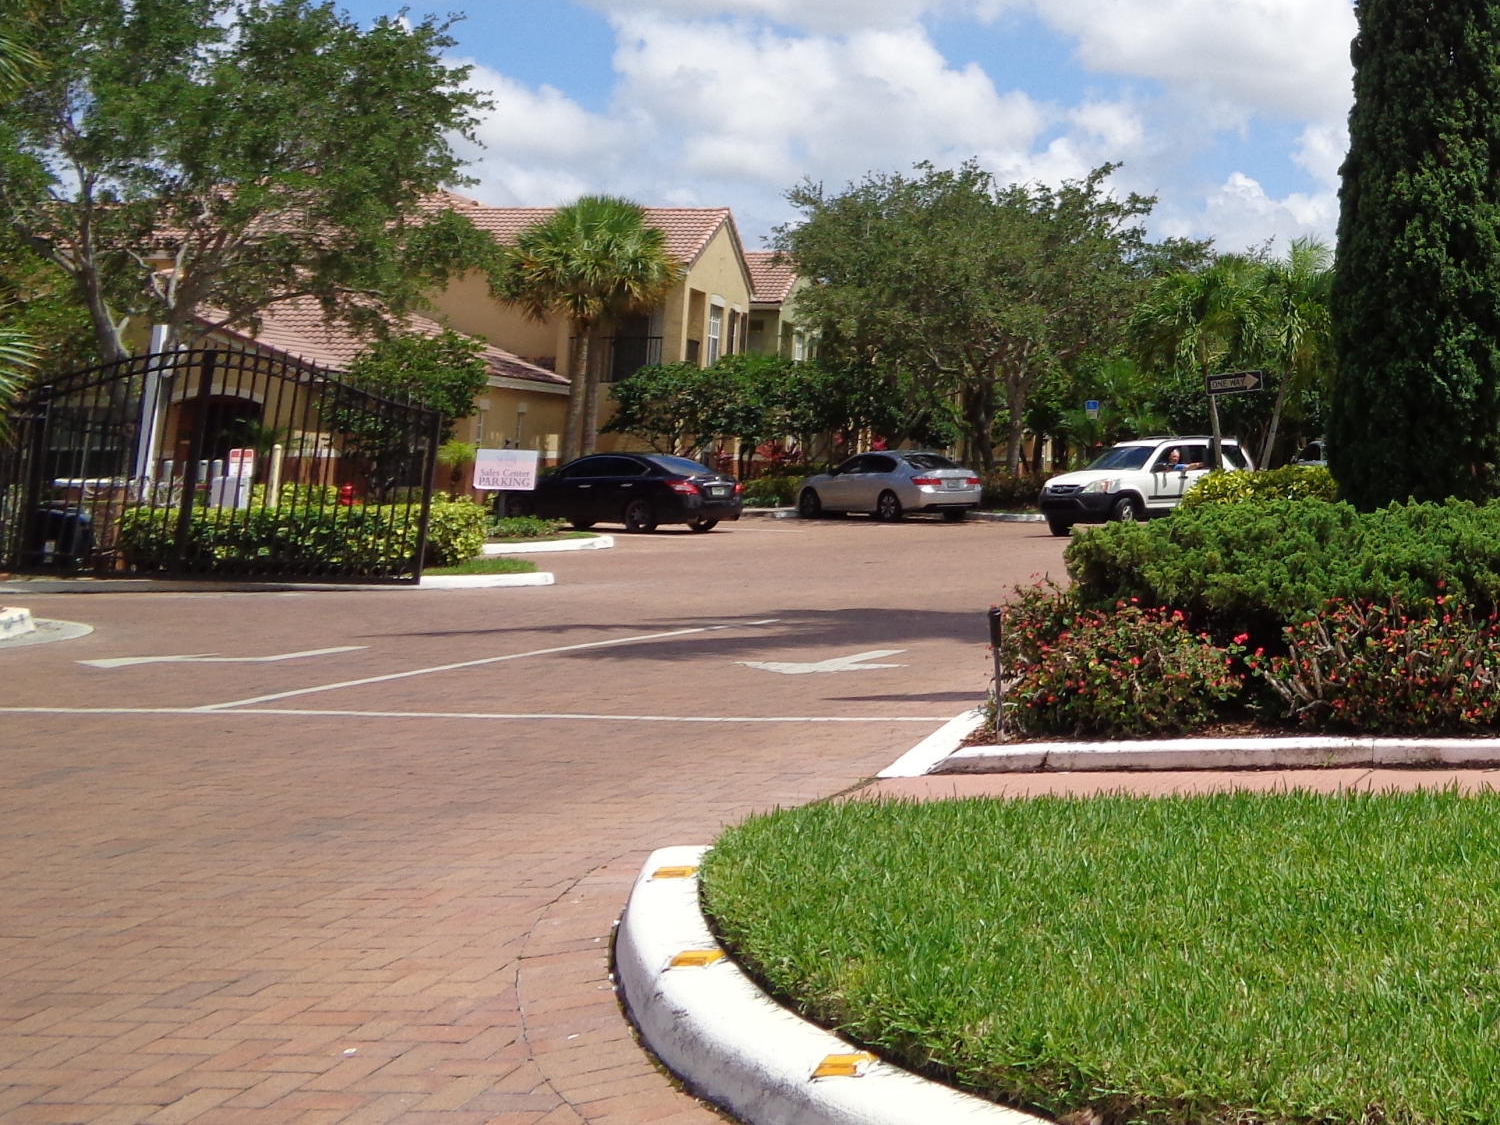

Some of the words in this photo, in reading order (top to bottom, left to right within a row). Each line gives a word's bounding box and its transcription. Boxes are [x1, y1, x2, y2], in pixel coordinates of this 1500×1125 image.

[1212, 379, 1228, 388] ONE
[1230, 378, 1245, 386] WAY
[480, 468, 500, 477] Sales
[502, 468, 530, 477] Center
[479, 477, 530, 487] PARKING
